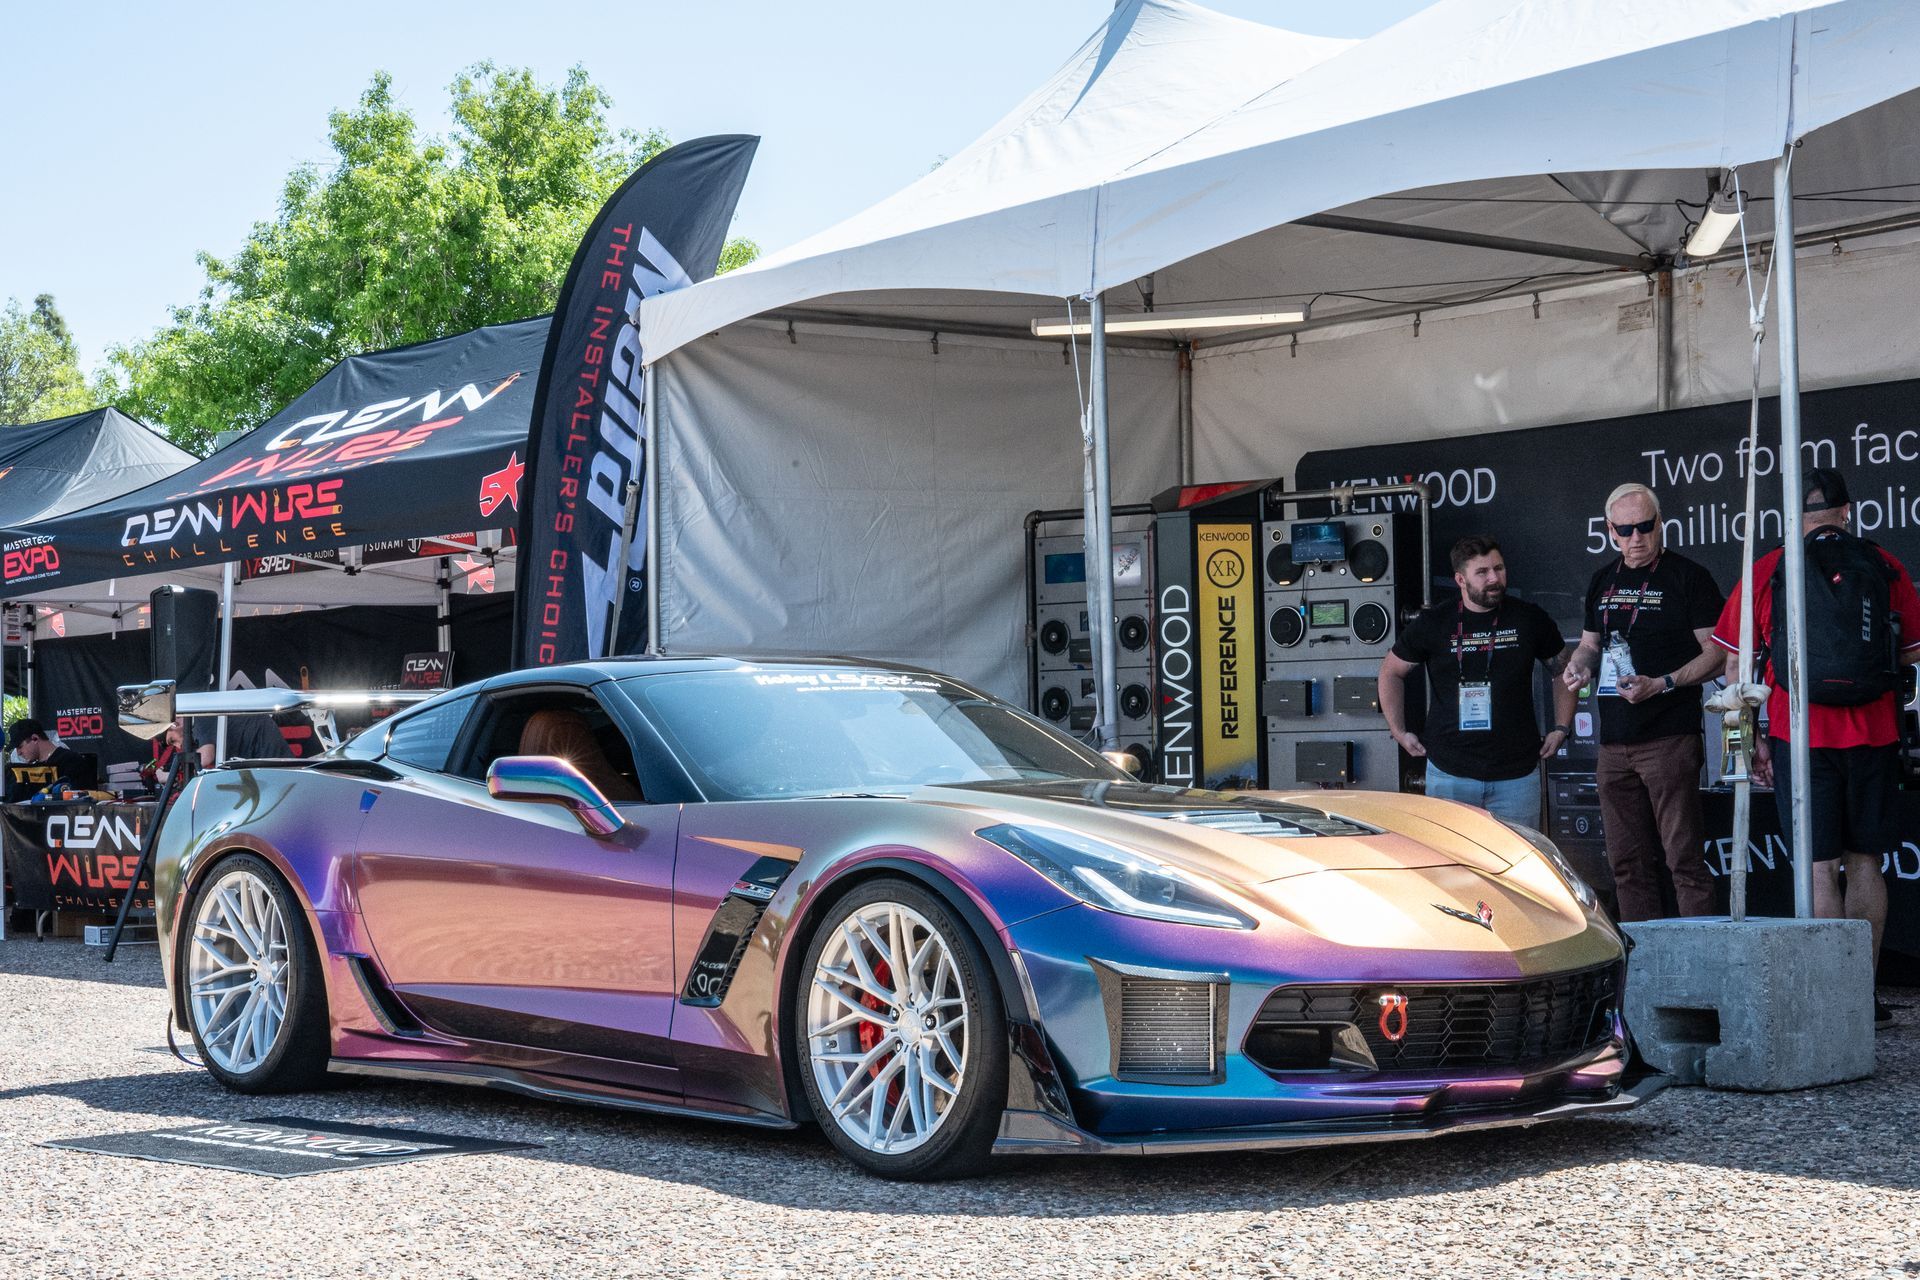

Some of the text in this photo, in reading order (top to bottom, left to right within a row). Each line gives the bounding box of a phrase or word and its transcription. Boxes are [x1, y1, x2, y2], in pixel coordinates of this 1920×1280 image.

[601, 223, 632, 291] THE
[554, 305, 613, 533] INSTALLER'S
[1641, 449, 1724, 488] Two
[231, 479, 344, 529] WIRE
[1330, 467, 1497, 515] KENWOOD
[122, 522, 346, 567] CHALLENGE
[1199, 531, 1250, 542] KENWOOD
[1586, 517, 1622, 554] 5
[4, 545, 60, 579] EXPO
[313, 549, 334, 559] AUDIO
[1211, 560, 1239, 577] XR
[1861, 595, 1871, 642] ELITE
[404, 671, 443, 684] WIRE
[406, 658, 444, 672] CLEAN
[1218, 595, 1239, 739] REFERENCE
[1161, 584, 1194, 787] ENWOOD
[56, 707, 103, 717] MASTERTECH
[57, 715, 104, 737] EXPO
[47, 853, 149, 889] WIRE
[55, 895, 156, 909] CHALLEGE
